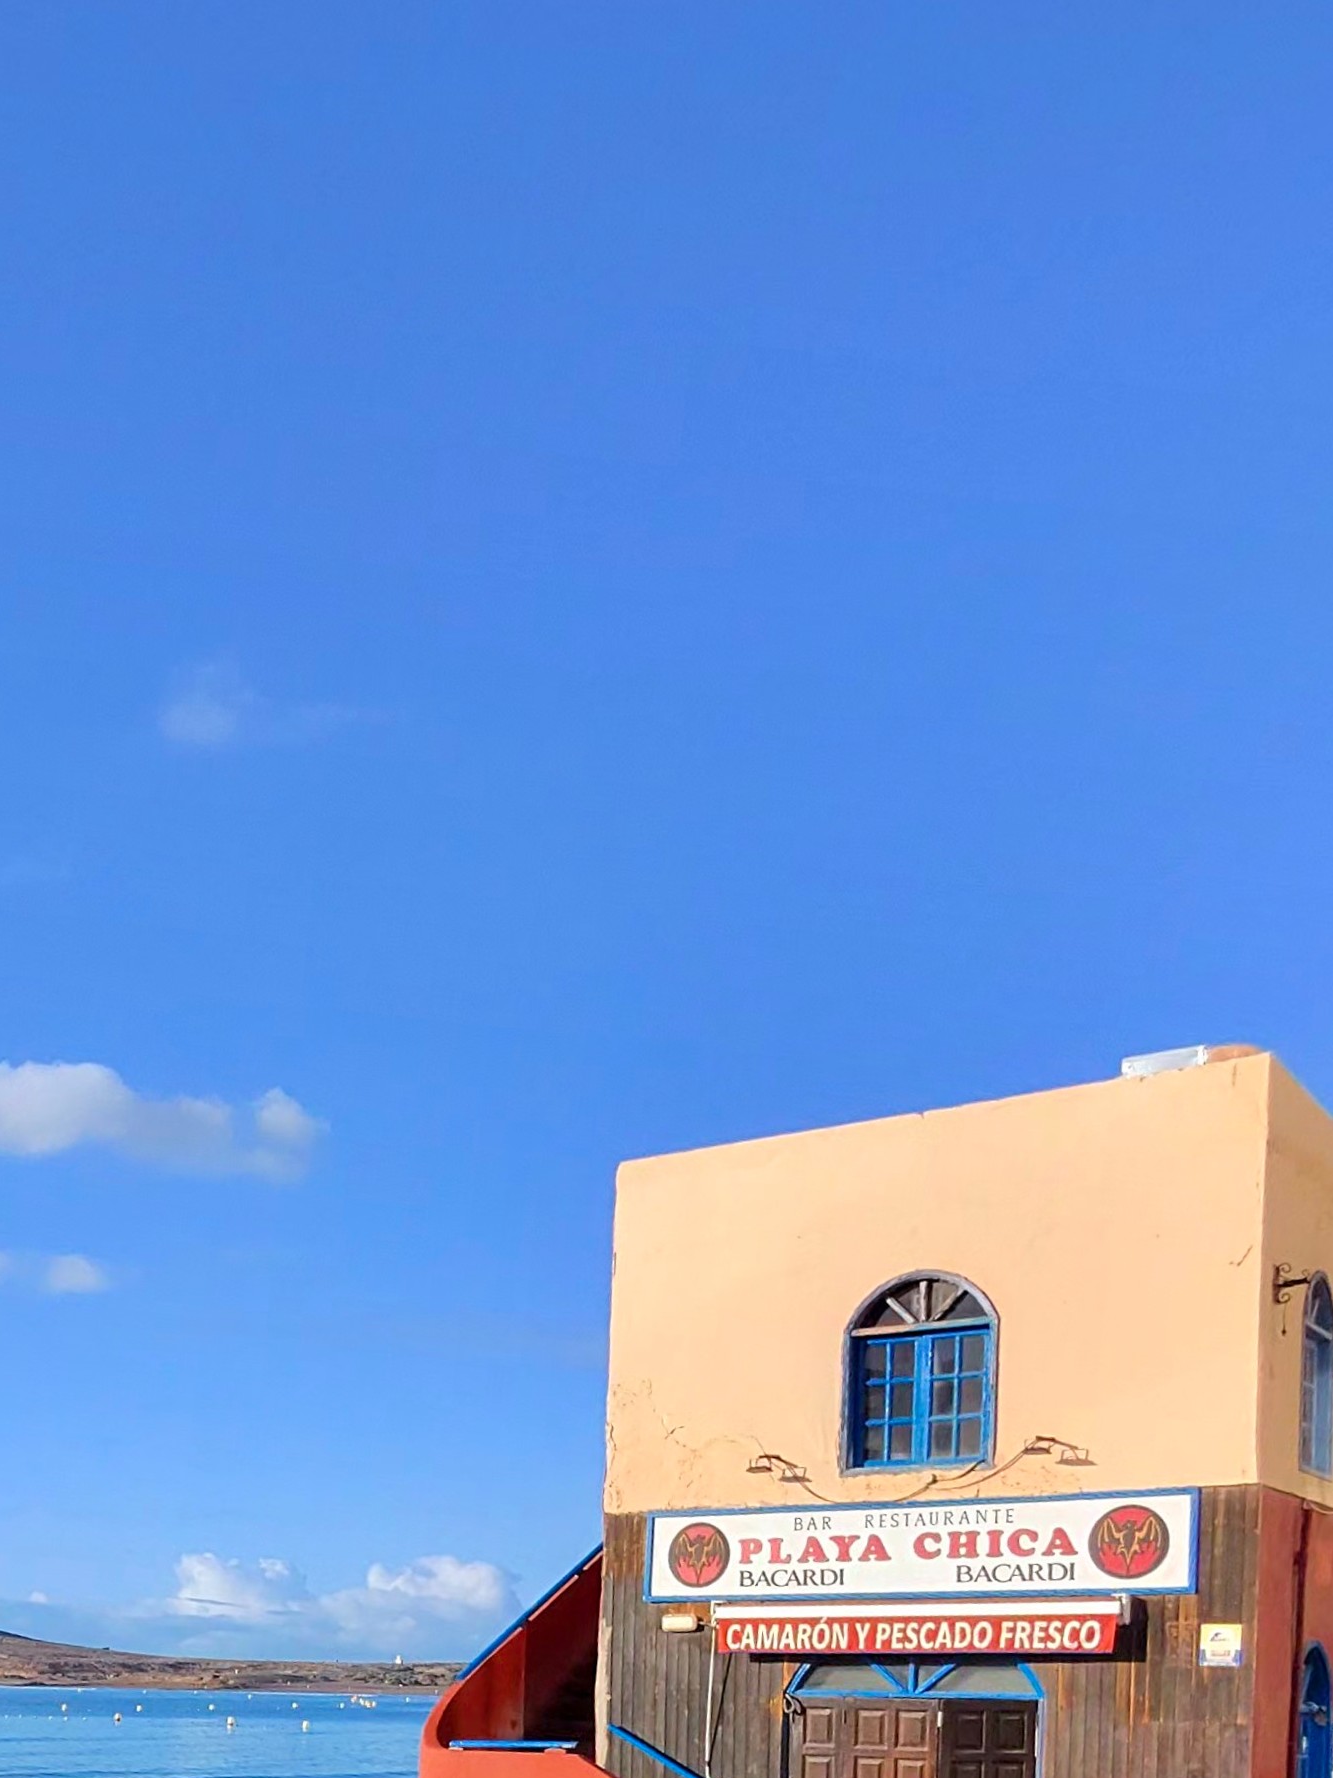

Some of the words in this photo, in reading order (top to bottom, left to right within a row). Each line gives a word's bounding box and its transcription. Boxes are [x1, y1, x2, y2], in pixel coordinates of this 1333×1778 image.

[793, 1516, 832, 1531] BAR
[864, 1508, 1015, 1529] RESTAURANTE
[738, 1534, 892, 1564] PLAYA
[913, 1527, 1079, 1560] CHICA
[739, 1568, 845, 1587] BACARDI
[956, 1562, 1075, 1583] BACARDI
[726, 1617, 849, 1650] CAMARÓN
[855, 1622, 871, 1650] Y
[875, 1621, 993, 1650] PESCADO
[999, 1620, 1101, 1650] FRESCO
